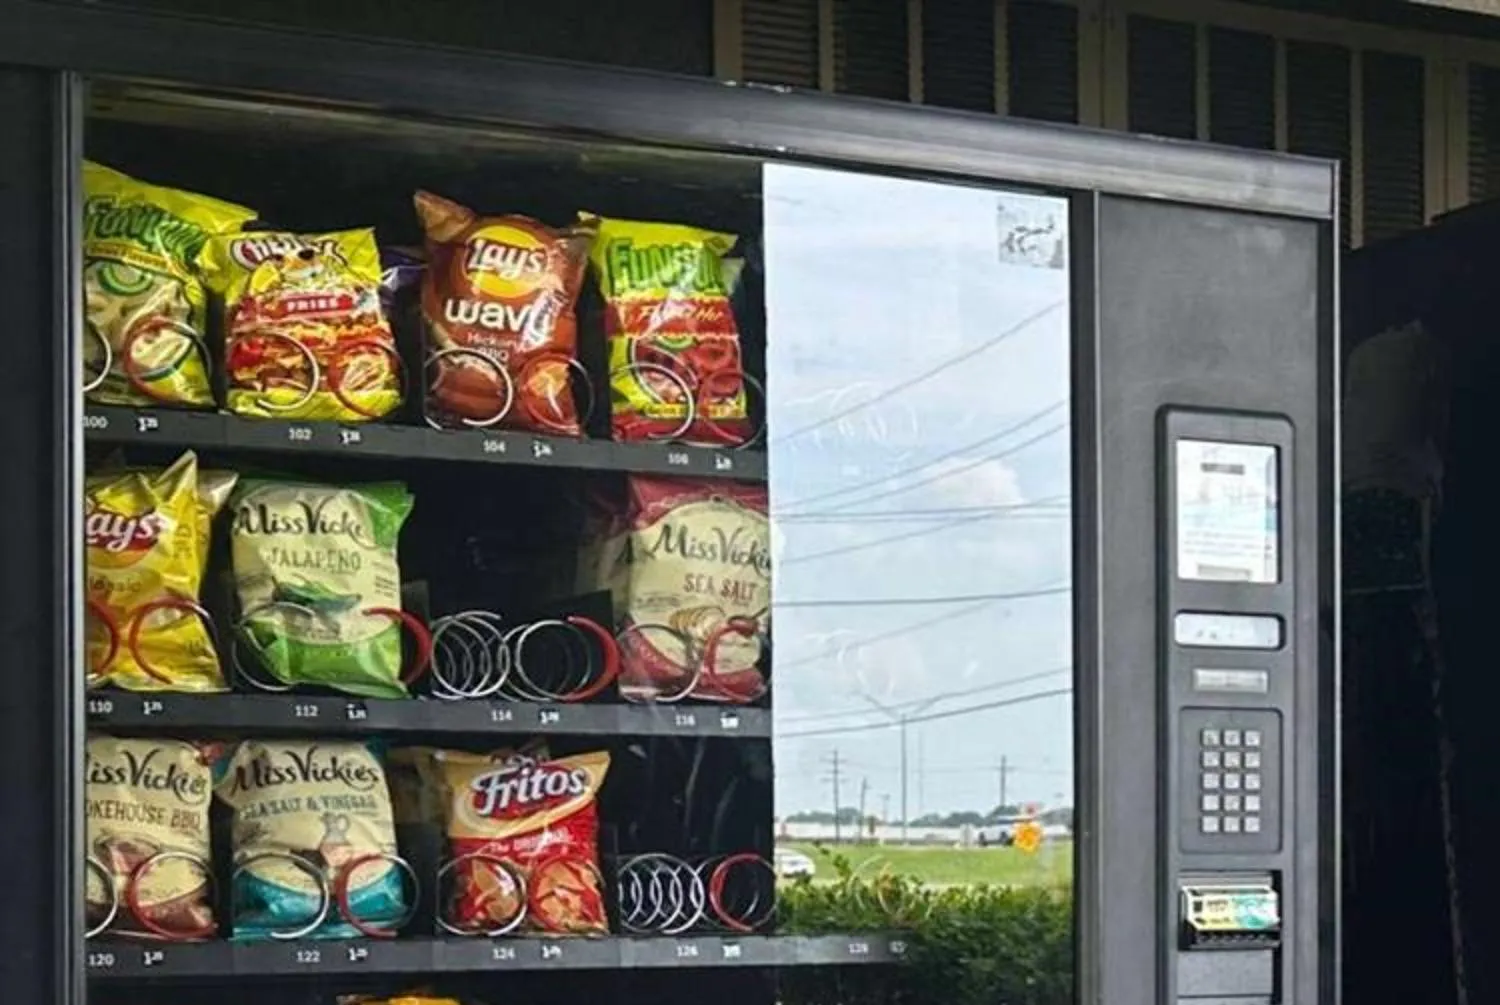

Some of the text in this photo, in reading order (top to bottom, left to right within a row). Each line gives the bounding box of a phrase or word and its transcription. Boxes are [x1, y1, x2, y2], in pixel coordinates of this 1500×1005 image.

[288, 427, 313, 440] 102
[88, 700, 113, 713] 110
[294, 704, 319, 717] 112
[470, 767, 586, 816] Fritos
[88, 953, 116, 967] 120
[297, 950, 321, 964] 122
